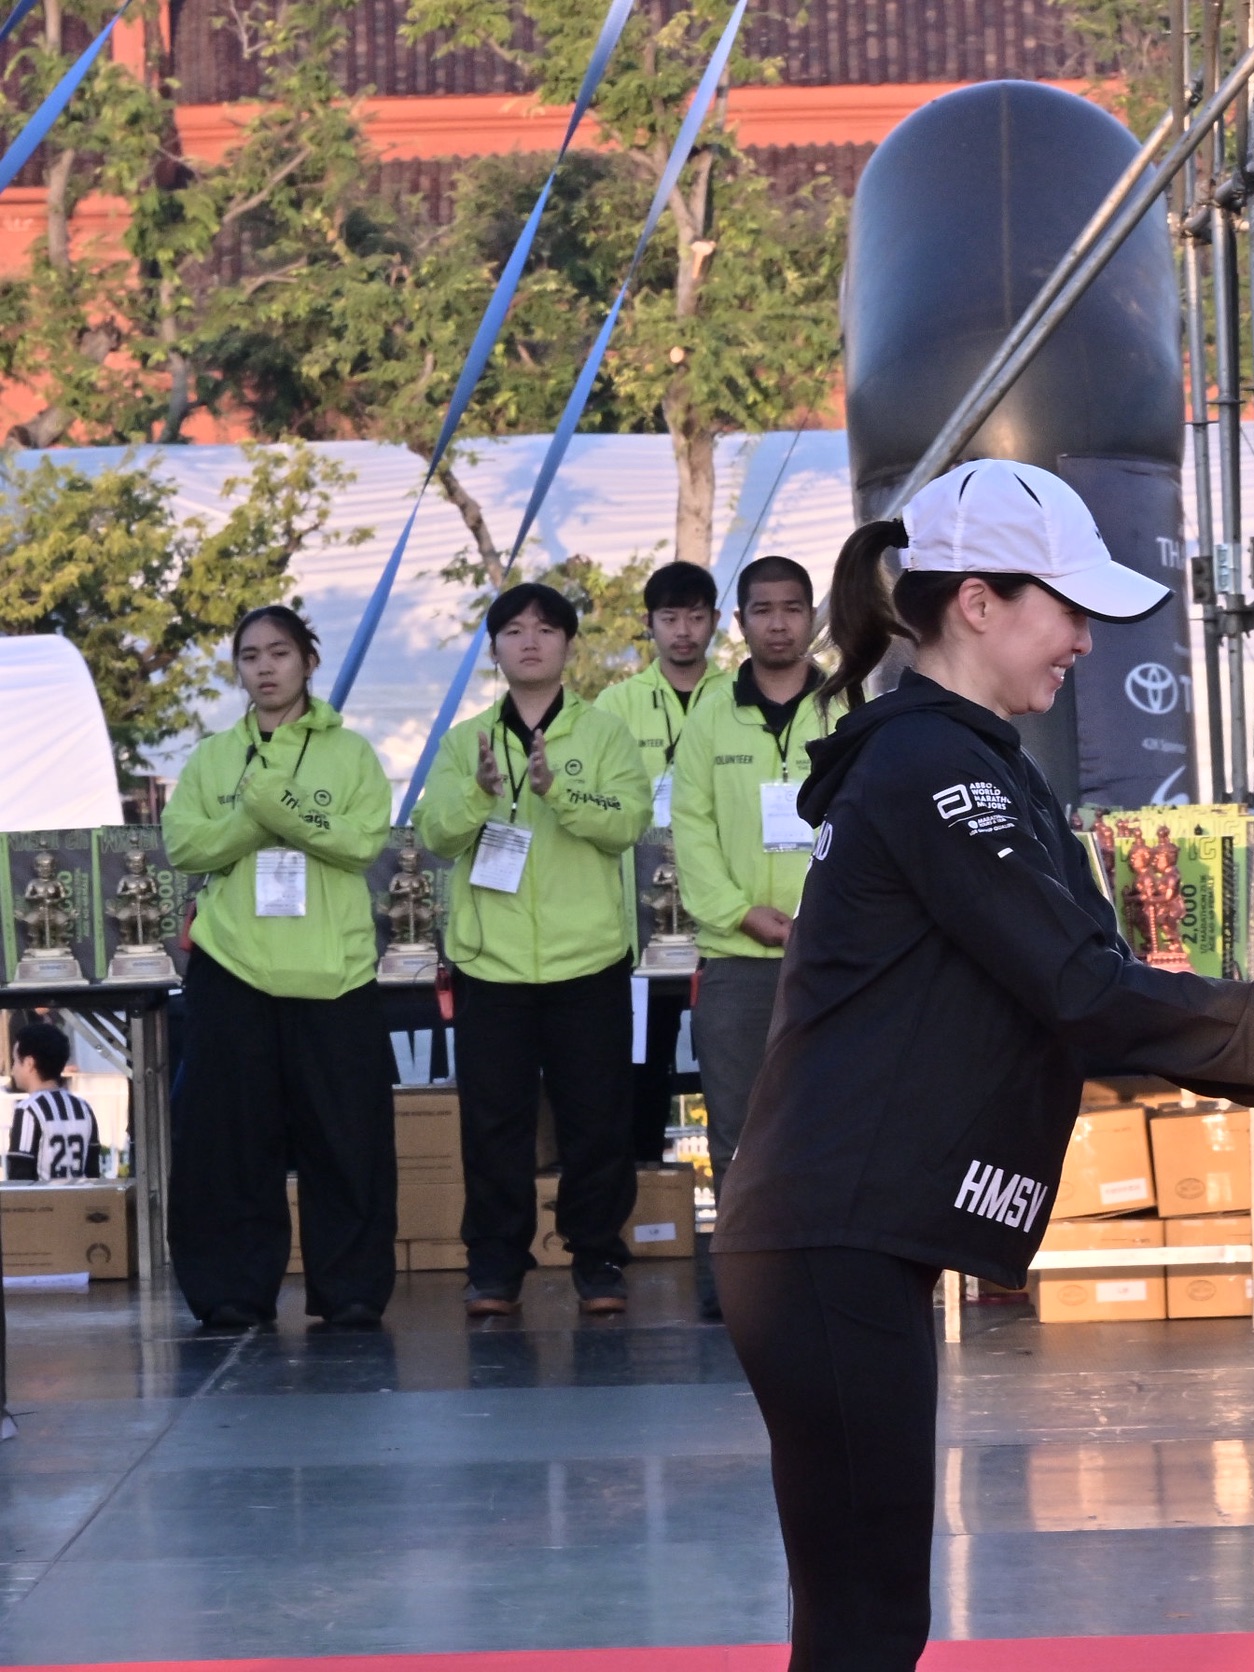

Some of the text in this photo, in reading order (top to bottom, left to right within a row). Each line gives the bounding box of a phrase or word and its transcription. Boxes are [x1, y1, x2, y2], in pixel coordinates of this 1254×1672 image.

[971, 788, 1001, 796] WORLD
[974, 795, 1011, 804] MARATH
[1181, 884, 1197, 945] 2,000
[49, 1134, 84, 1179] 23
